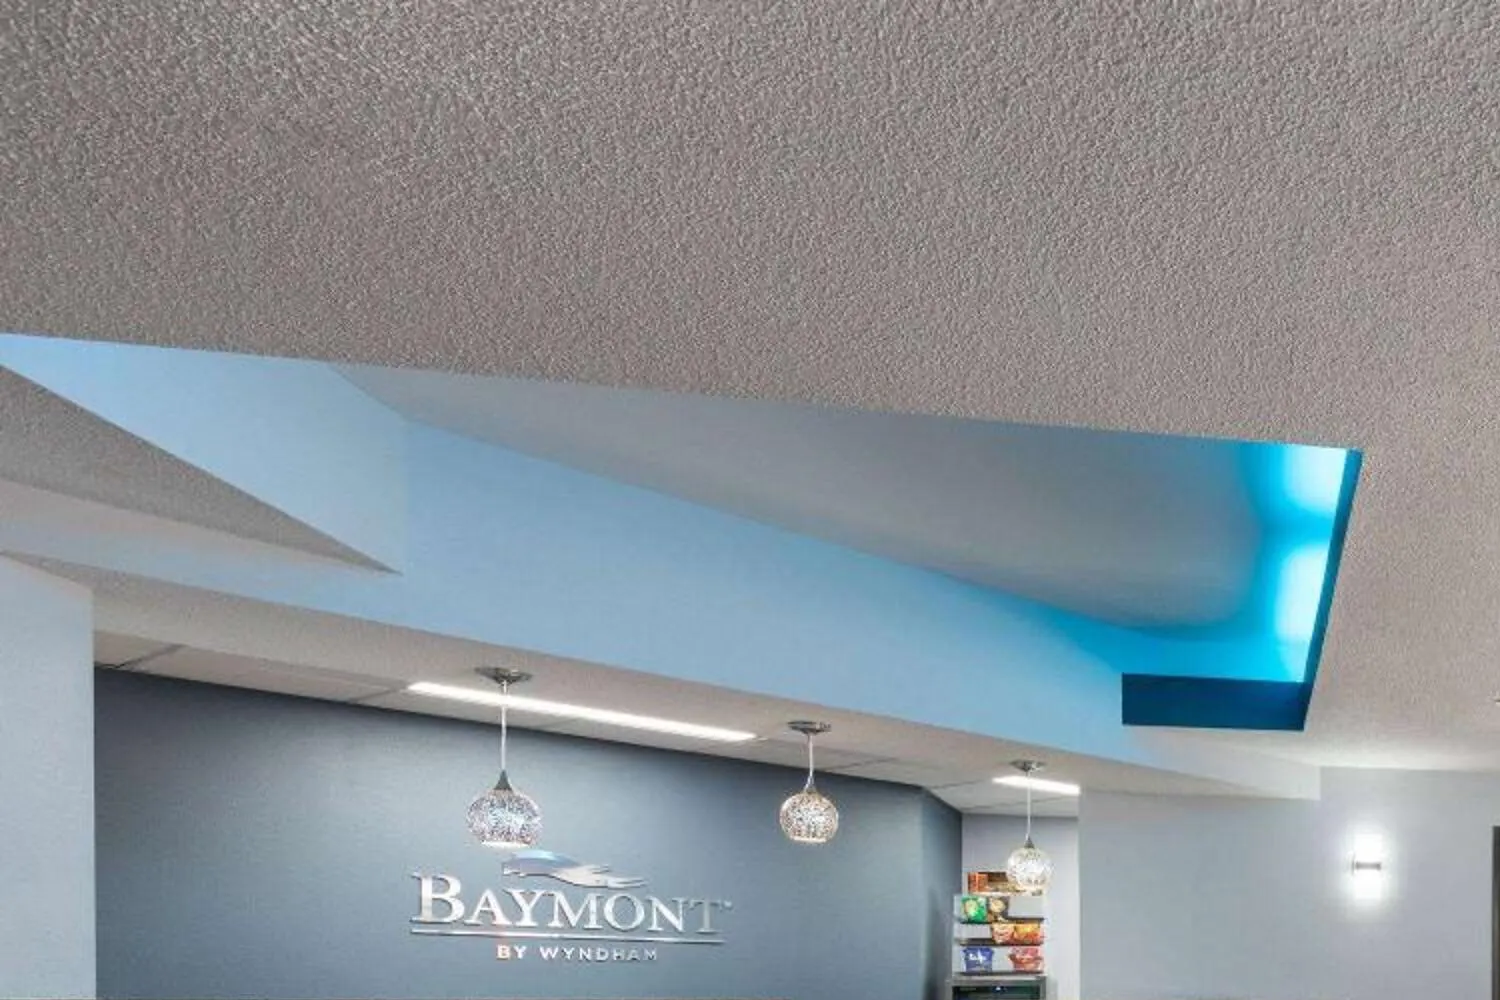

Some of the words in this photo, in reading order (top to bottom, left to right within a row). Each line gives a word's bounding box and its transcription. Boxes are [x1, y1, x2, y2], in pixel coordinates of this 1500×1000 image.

[410, 871, 723, 934] BAYMONT
[496, 944, 527, 960] BY
[539, 946, 658, 962] WYNDHAM
